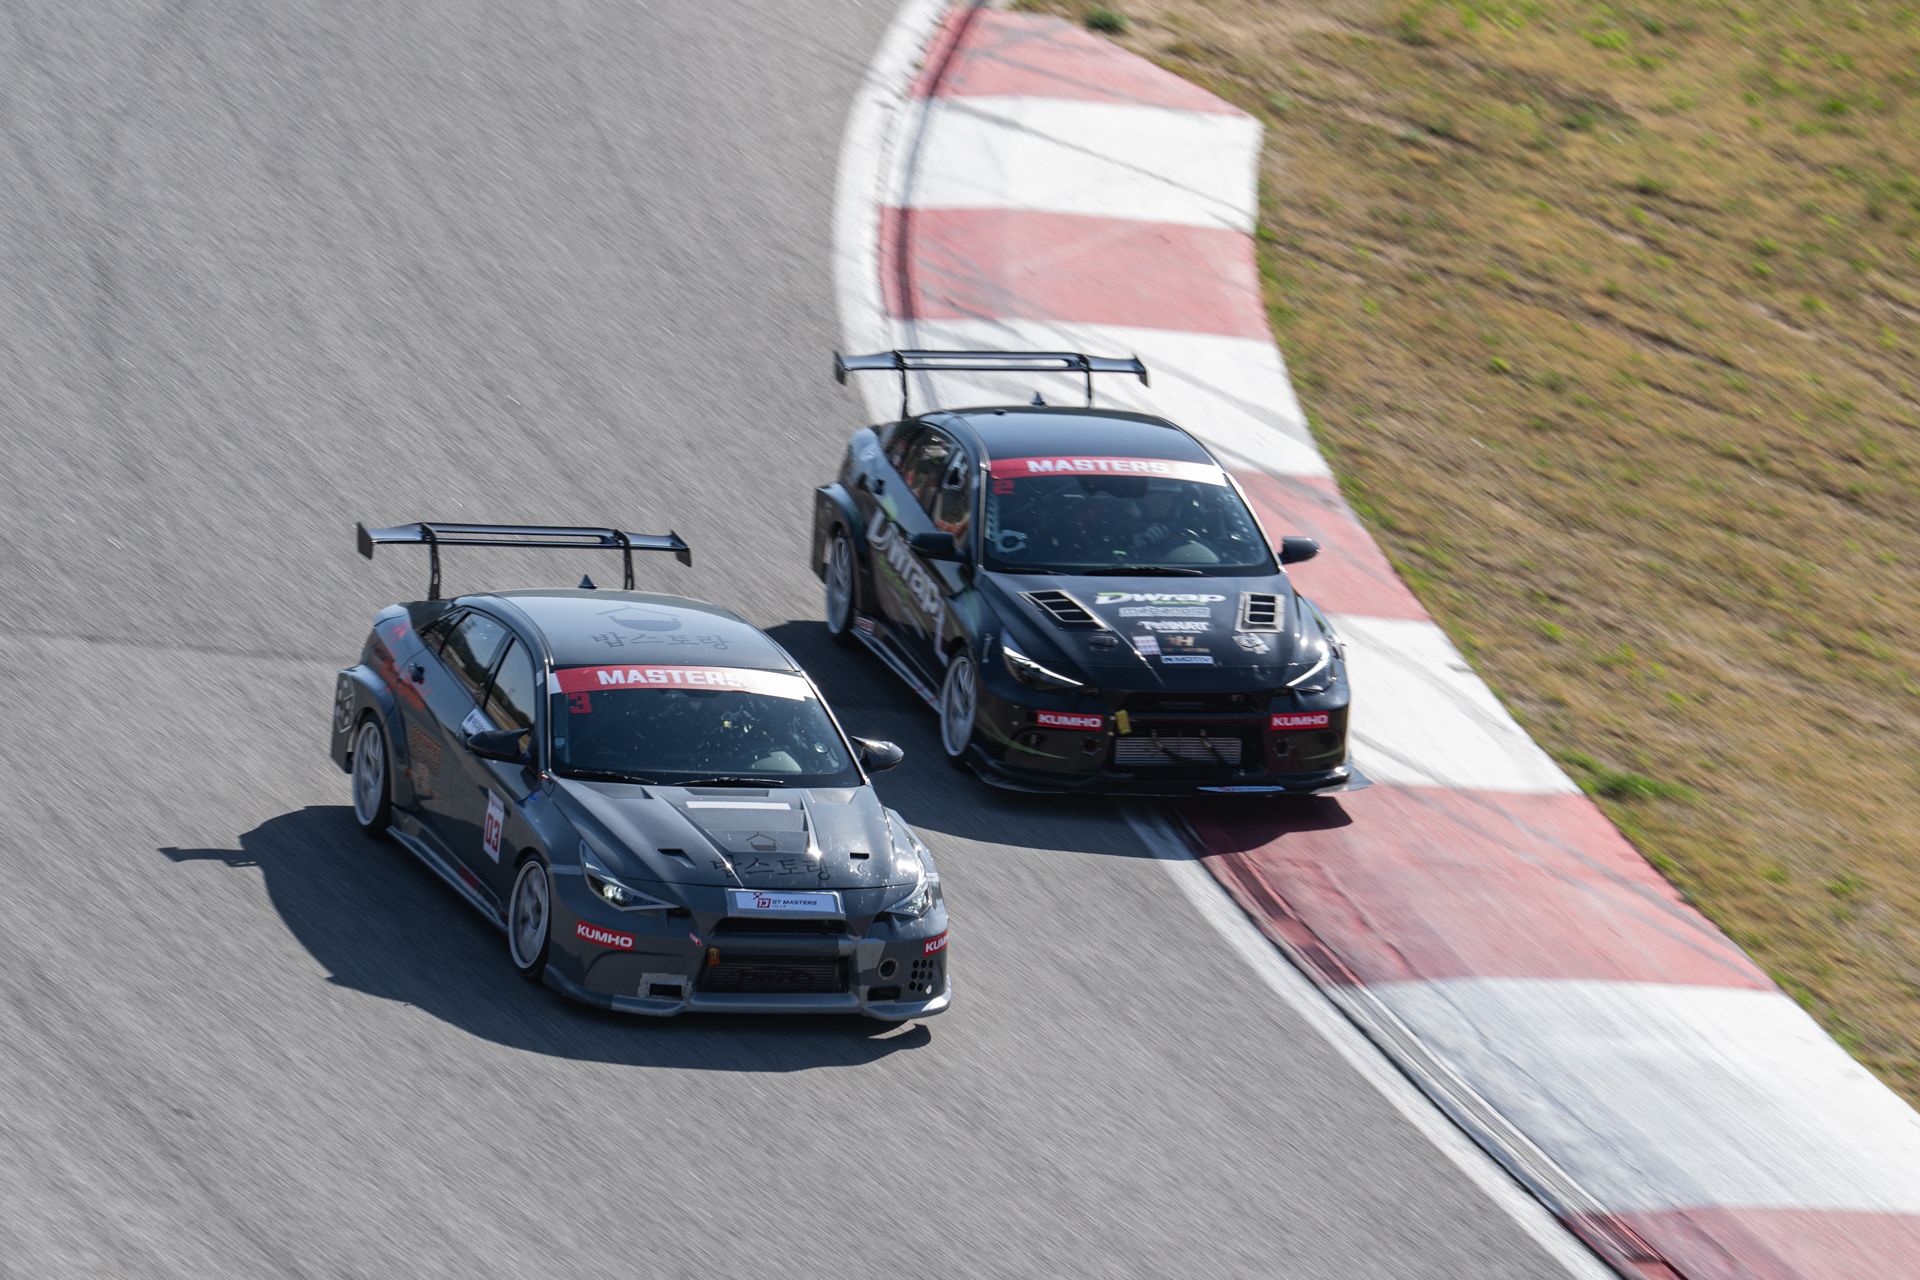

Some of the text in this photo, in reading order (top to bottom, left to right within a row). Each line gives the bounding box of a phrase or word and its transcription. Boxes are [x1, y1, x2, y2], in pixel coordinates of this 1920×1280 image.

[1026, 459, 1169, 474] MASTERS
[1095, 591, 1227, 605] Dwrap
[592, 631, 732, 650] 밥스토랑
[597, 669, 748, 689] MASTERS
[569, 692, 592, 714] 3
[1038, 713, 1102, 728] KUMHO
[1272, 714, 1329, 728] KUMHO
[485, 813, 500, 852] 03
[577, 924, 633, 948] KUMHO
